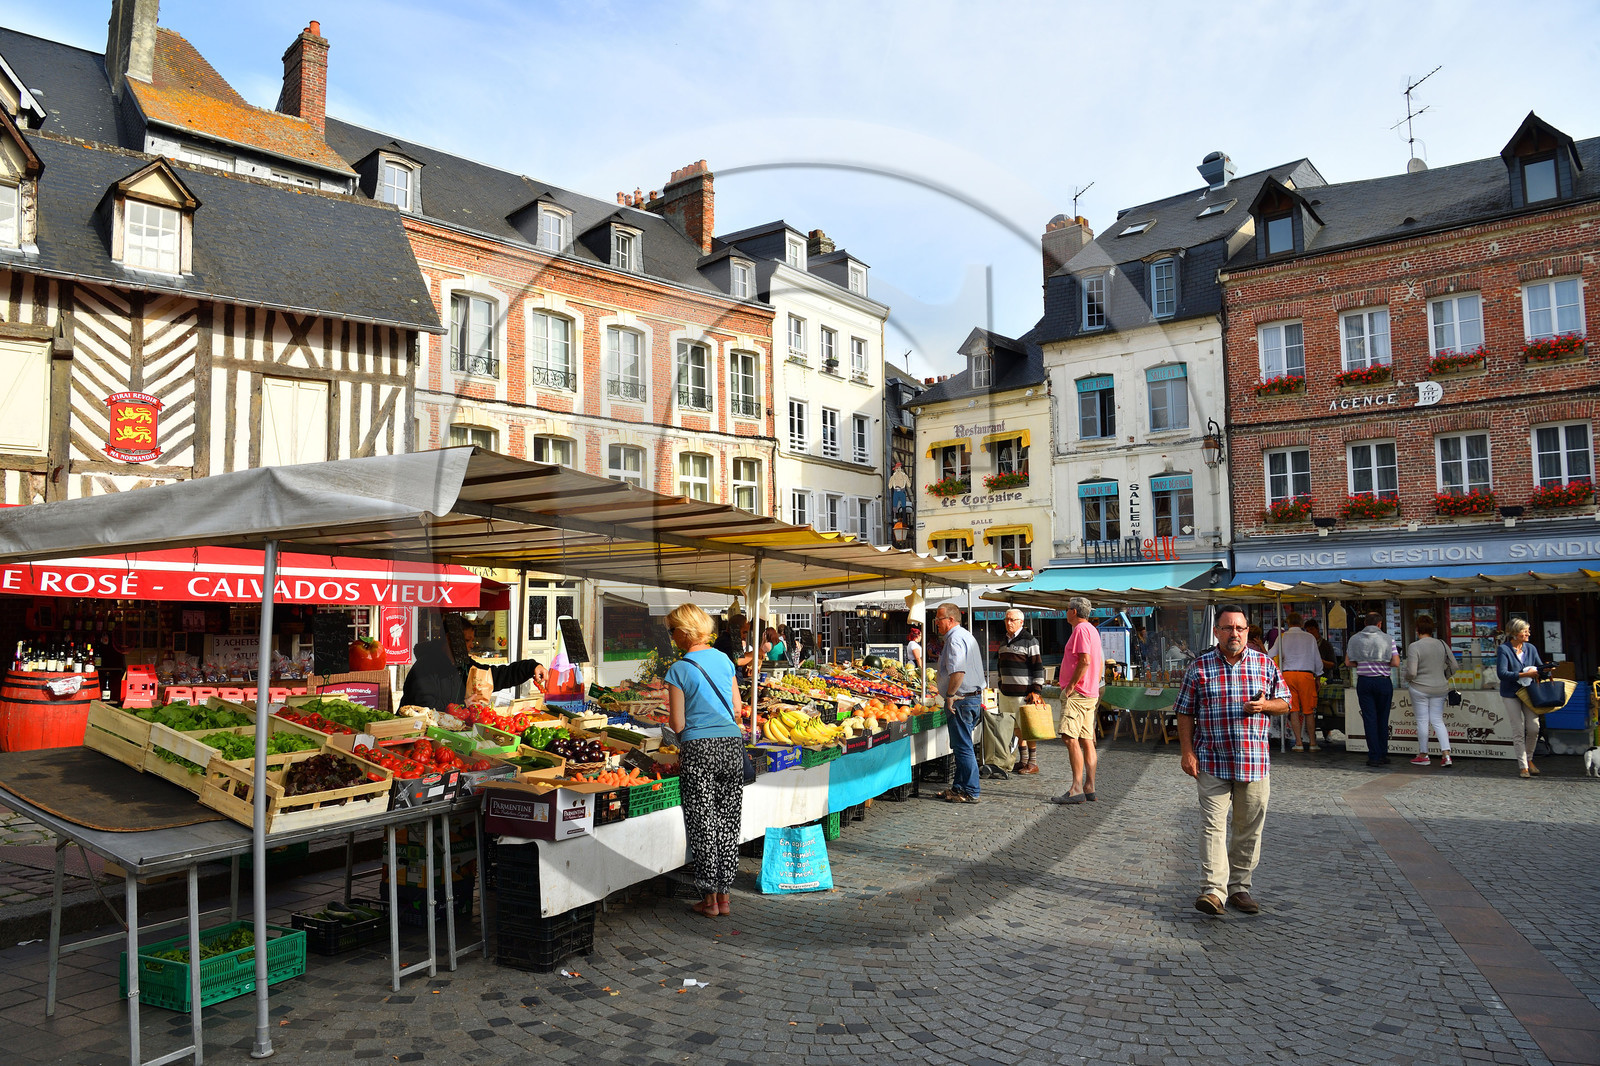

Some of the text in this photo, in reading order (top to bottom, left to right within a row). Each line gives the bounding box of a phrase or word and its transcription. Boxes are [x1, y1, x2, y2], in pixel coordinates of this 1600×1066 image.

[111, 393, 158, 403] J'IRAI REVOIR
[1328, 393, 1397, 411] AGENCE
[953, 420, 1006, 438] Restaurant
[110, 450, 157, 461] MA NORMANDIE
[941, 492, 1022, 508] Le Corsaire
[1129, 484, 1140, 521] SALLE
[1084, 536, 1142, 564] L'ATELIER
[1154, 535, 1180, 561] LUC
[1255, 551, 1348, 569] AGENCE
[1371, 545, 1483, 564] GESTION
[40, 572, 139, 595] ROSÉ
[187, 576, 361, 602] CALVADOS
[371, 583, 454, 604] VIEUX
[215, 639, 220, 647] 3
[1485, 749, 1507, 757] Blanc
[493, 800, 532, 812] PARMENTINE
[563, 808, 585, 817] PARMENTINE
[779, 838, 790, 846] En
[782, 848, 816, 859] ensemble
[796, 859, 810, 871] agit
